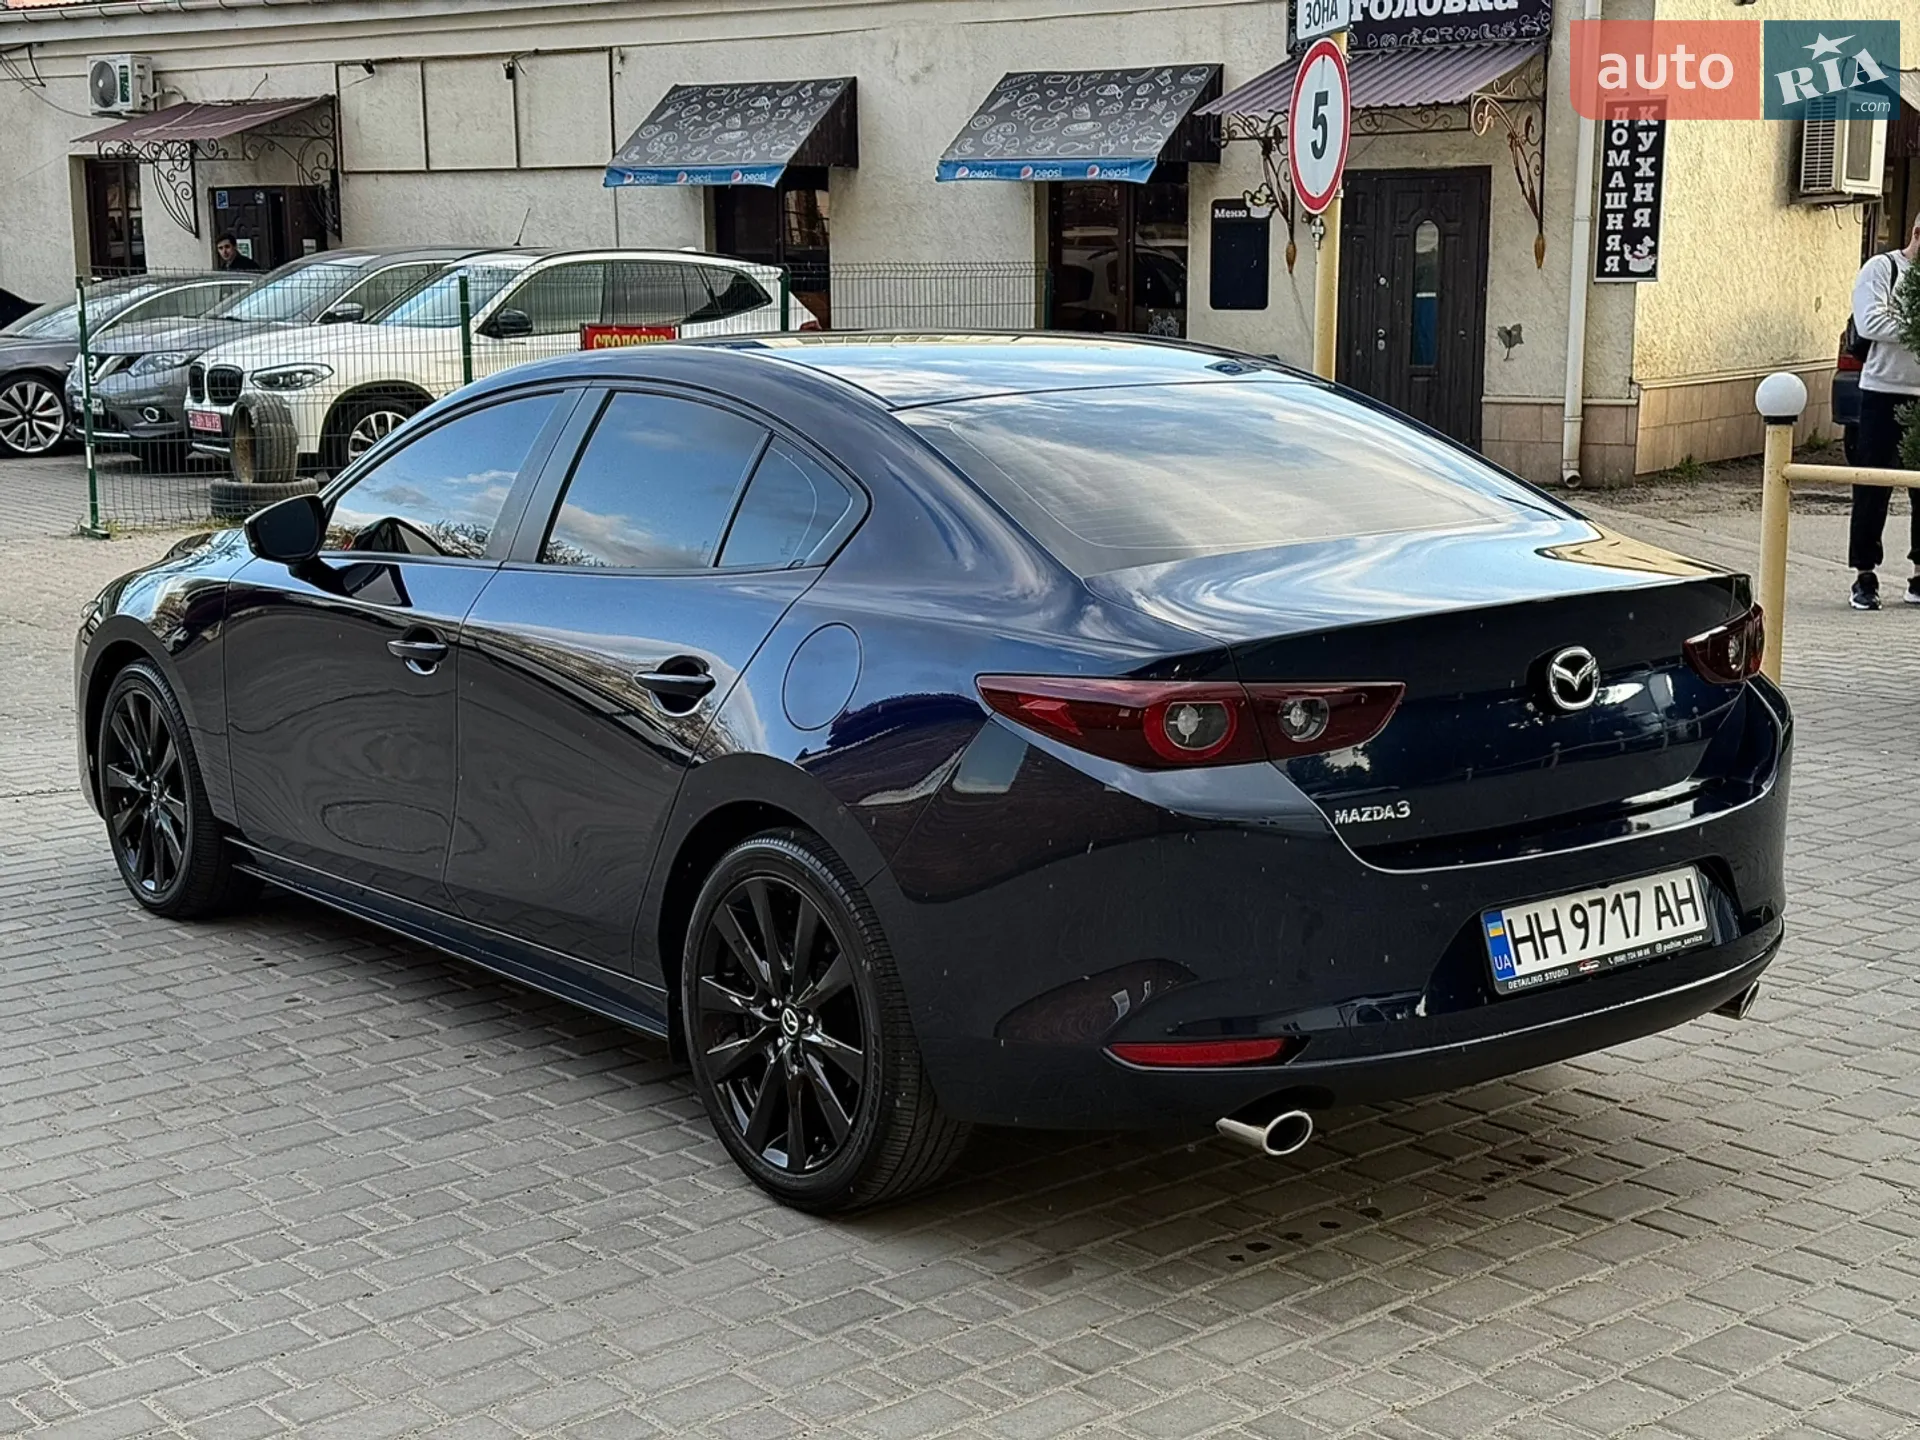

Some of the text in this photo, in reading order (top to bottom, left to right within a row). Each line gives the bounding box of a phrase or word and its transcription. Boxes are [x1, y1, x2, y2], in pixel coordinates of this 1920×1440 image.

[1305, 0, 1339, 29] ЗОНА
[1310, 90, 1329, 160] 5
[743, 171, 767, 183] pepsi
[969, 166, 1130, 179] pepsi pepsi pepsi
[1632, 106, 1658, 228] КУХНЯ
[1604, 107, 1630, 272] ДОМАШНЯЯ
[1214, 208, 1247, 218] Меню
[1506, 877, 1700, 965] HH 9717 AH
[1494, 953, 1514, 971] UA
[1508, 974, 1544, 989] DETAILING
[1544, 968, 1569, 981] STUDIO
